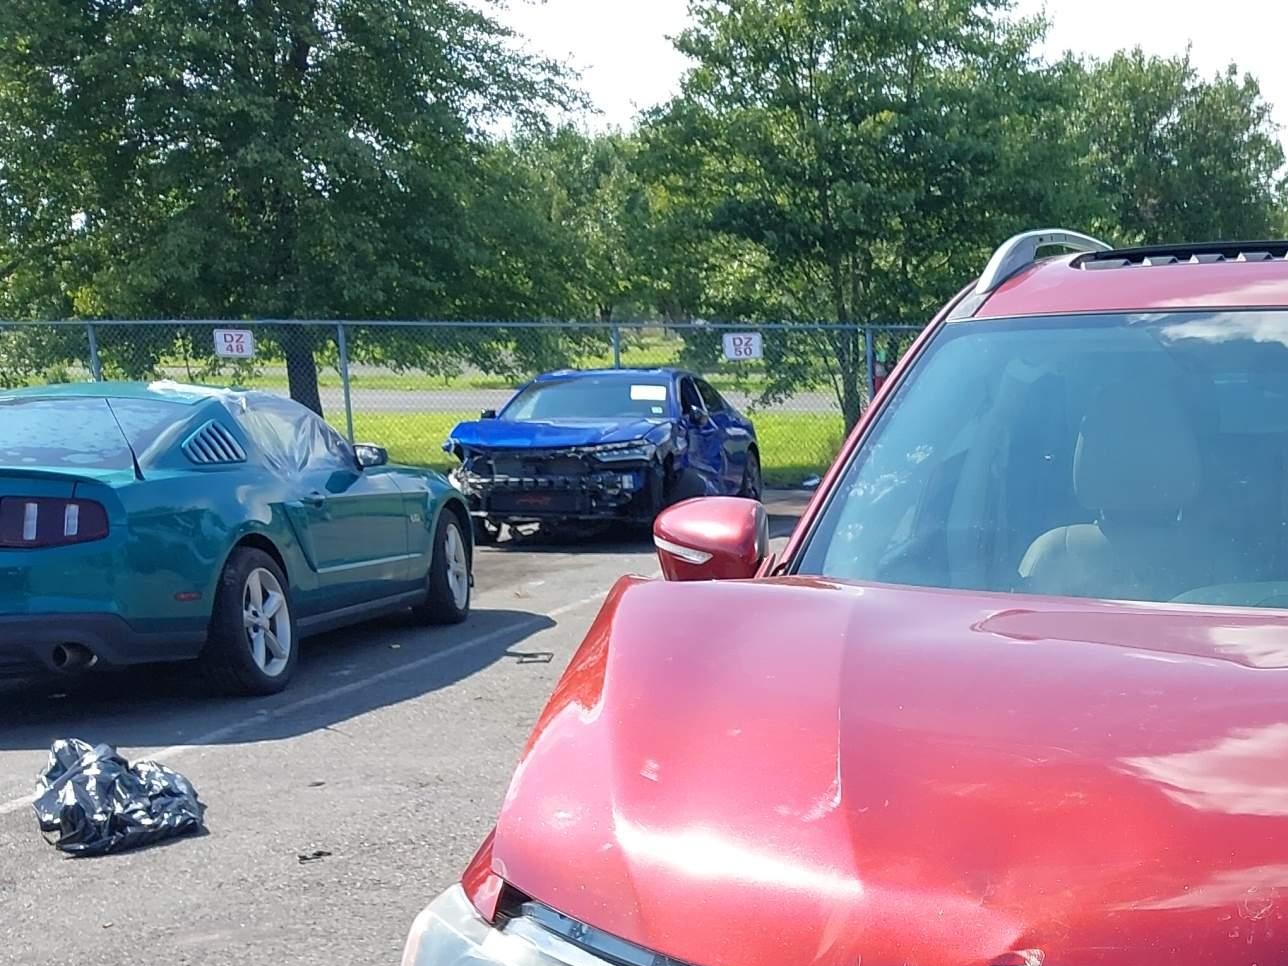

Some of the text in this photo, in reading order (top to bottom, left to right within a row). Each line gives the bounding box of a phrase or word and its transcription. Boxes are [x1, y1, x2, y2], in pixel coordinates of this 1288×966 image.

[223, 333, 245, 343] DZ
[732, 336, 753, 347] DZ
[225, 344, 244, 354] 48
[734, 347, 753, 357] 50
